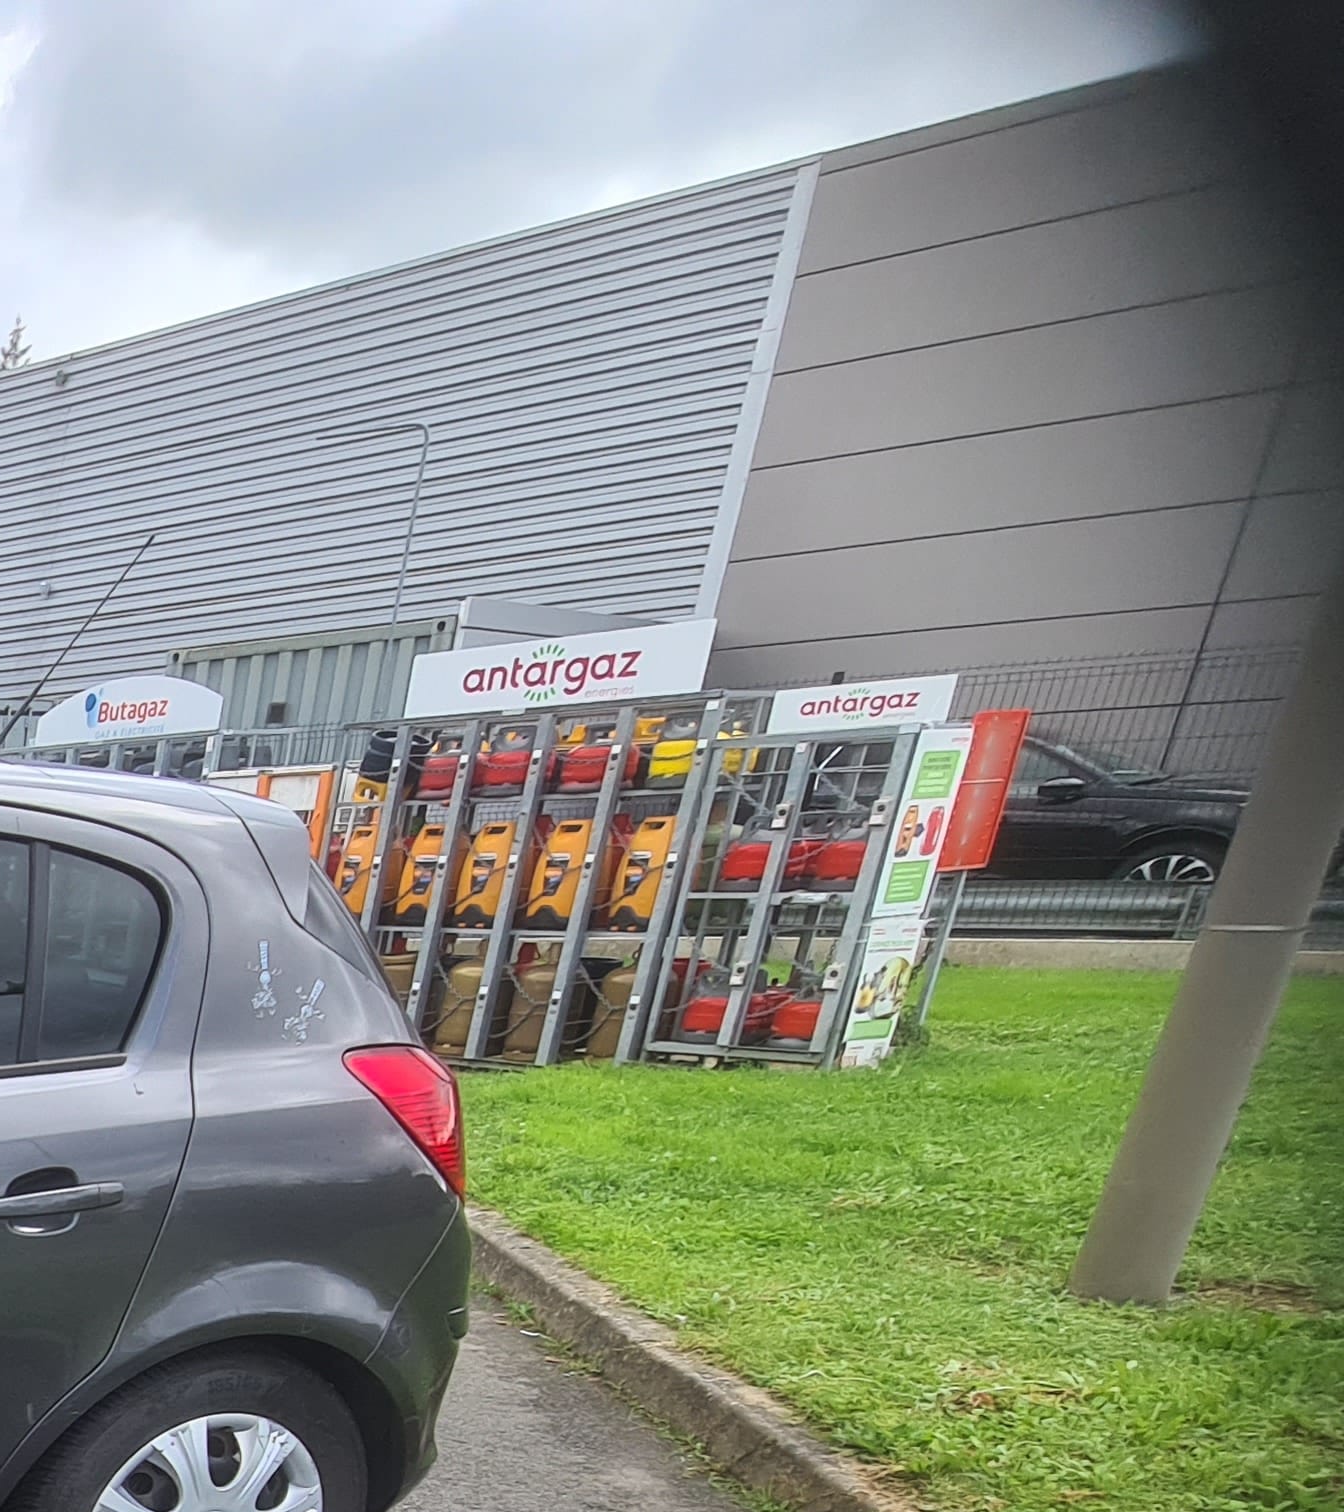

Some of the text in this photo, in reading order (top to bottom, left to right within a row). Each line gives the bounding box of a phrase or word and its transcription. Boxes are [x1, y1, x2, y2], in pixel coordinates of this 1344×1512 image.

[462, 650, 642, 696] antargaz
[97, 700, 169, 723] Butagaz
[800, 692, 920, 717] antargaz
